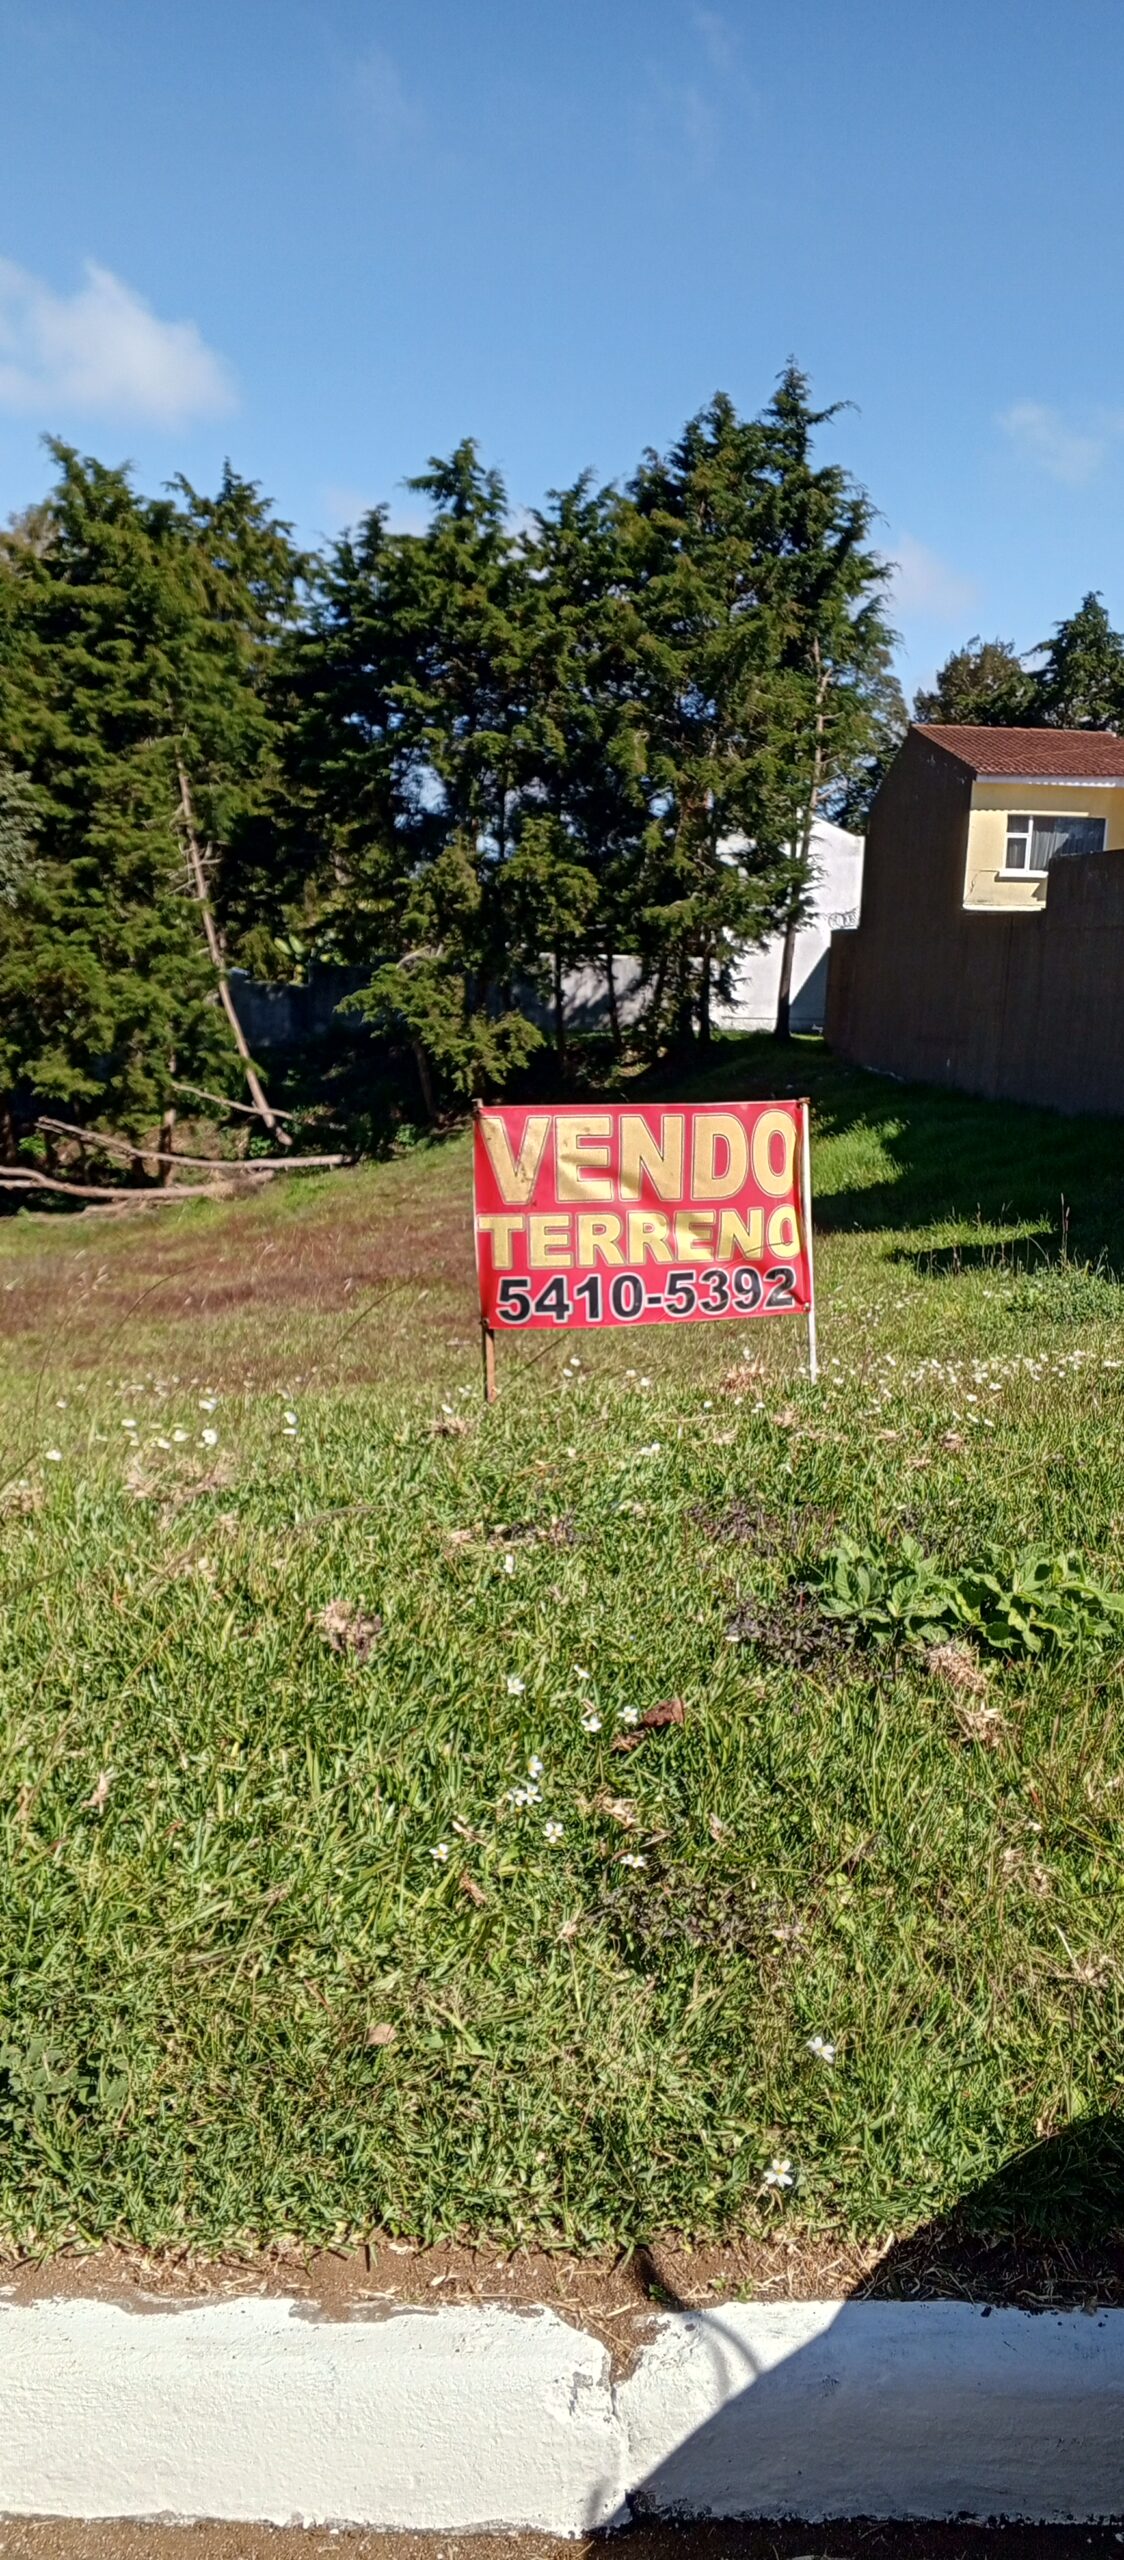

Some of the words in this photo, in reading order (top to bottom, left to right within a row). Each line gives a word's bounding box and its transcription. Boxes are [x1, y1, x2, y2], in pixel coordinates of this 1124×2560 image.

[477, 1109, 797, 1204] VENDO
[477, 1203, 800, 1269] TERRENO
[498, 1266, 796, 1323] 5410-5392
